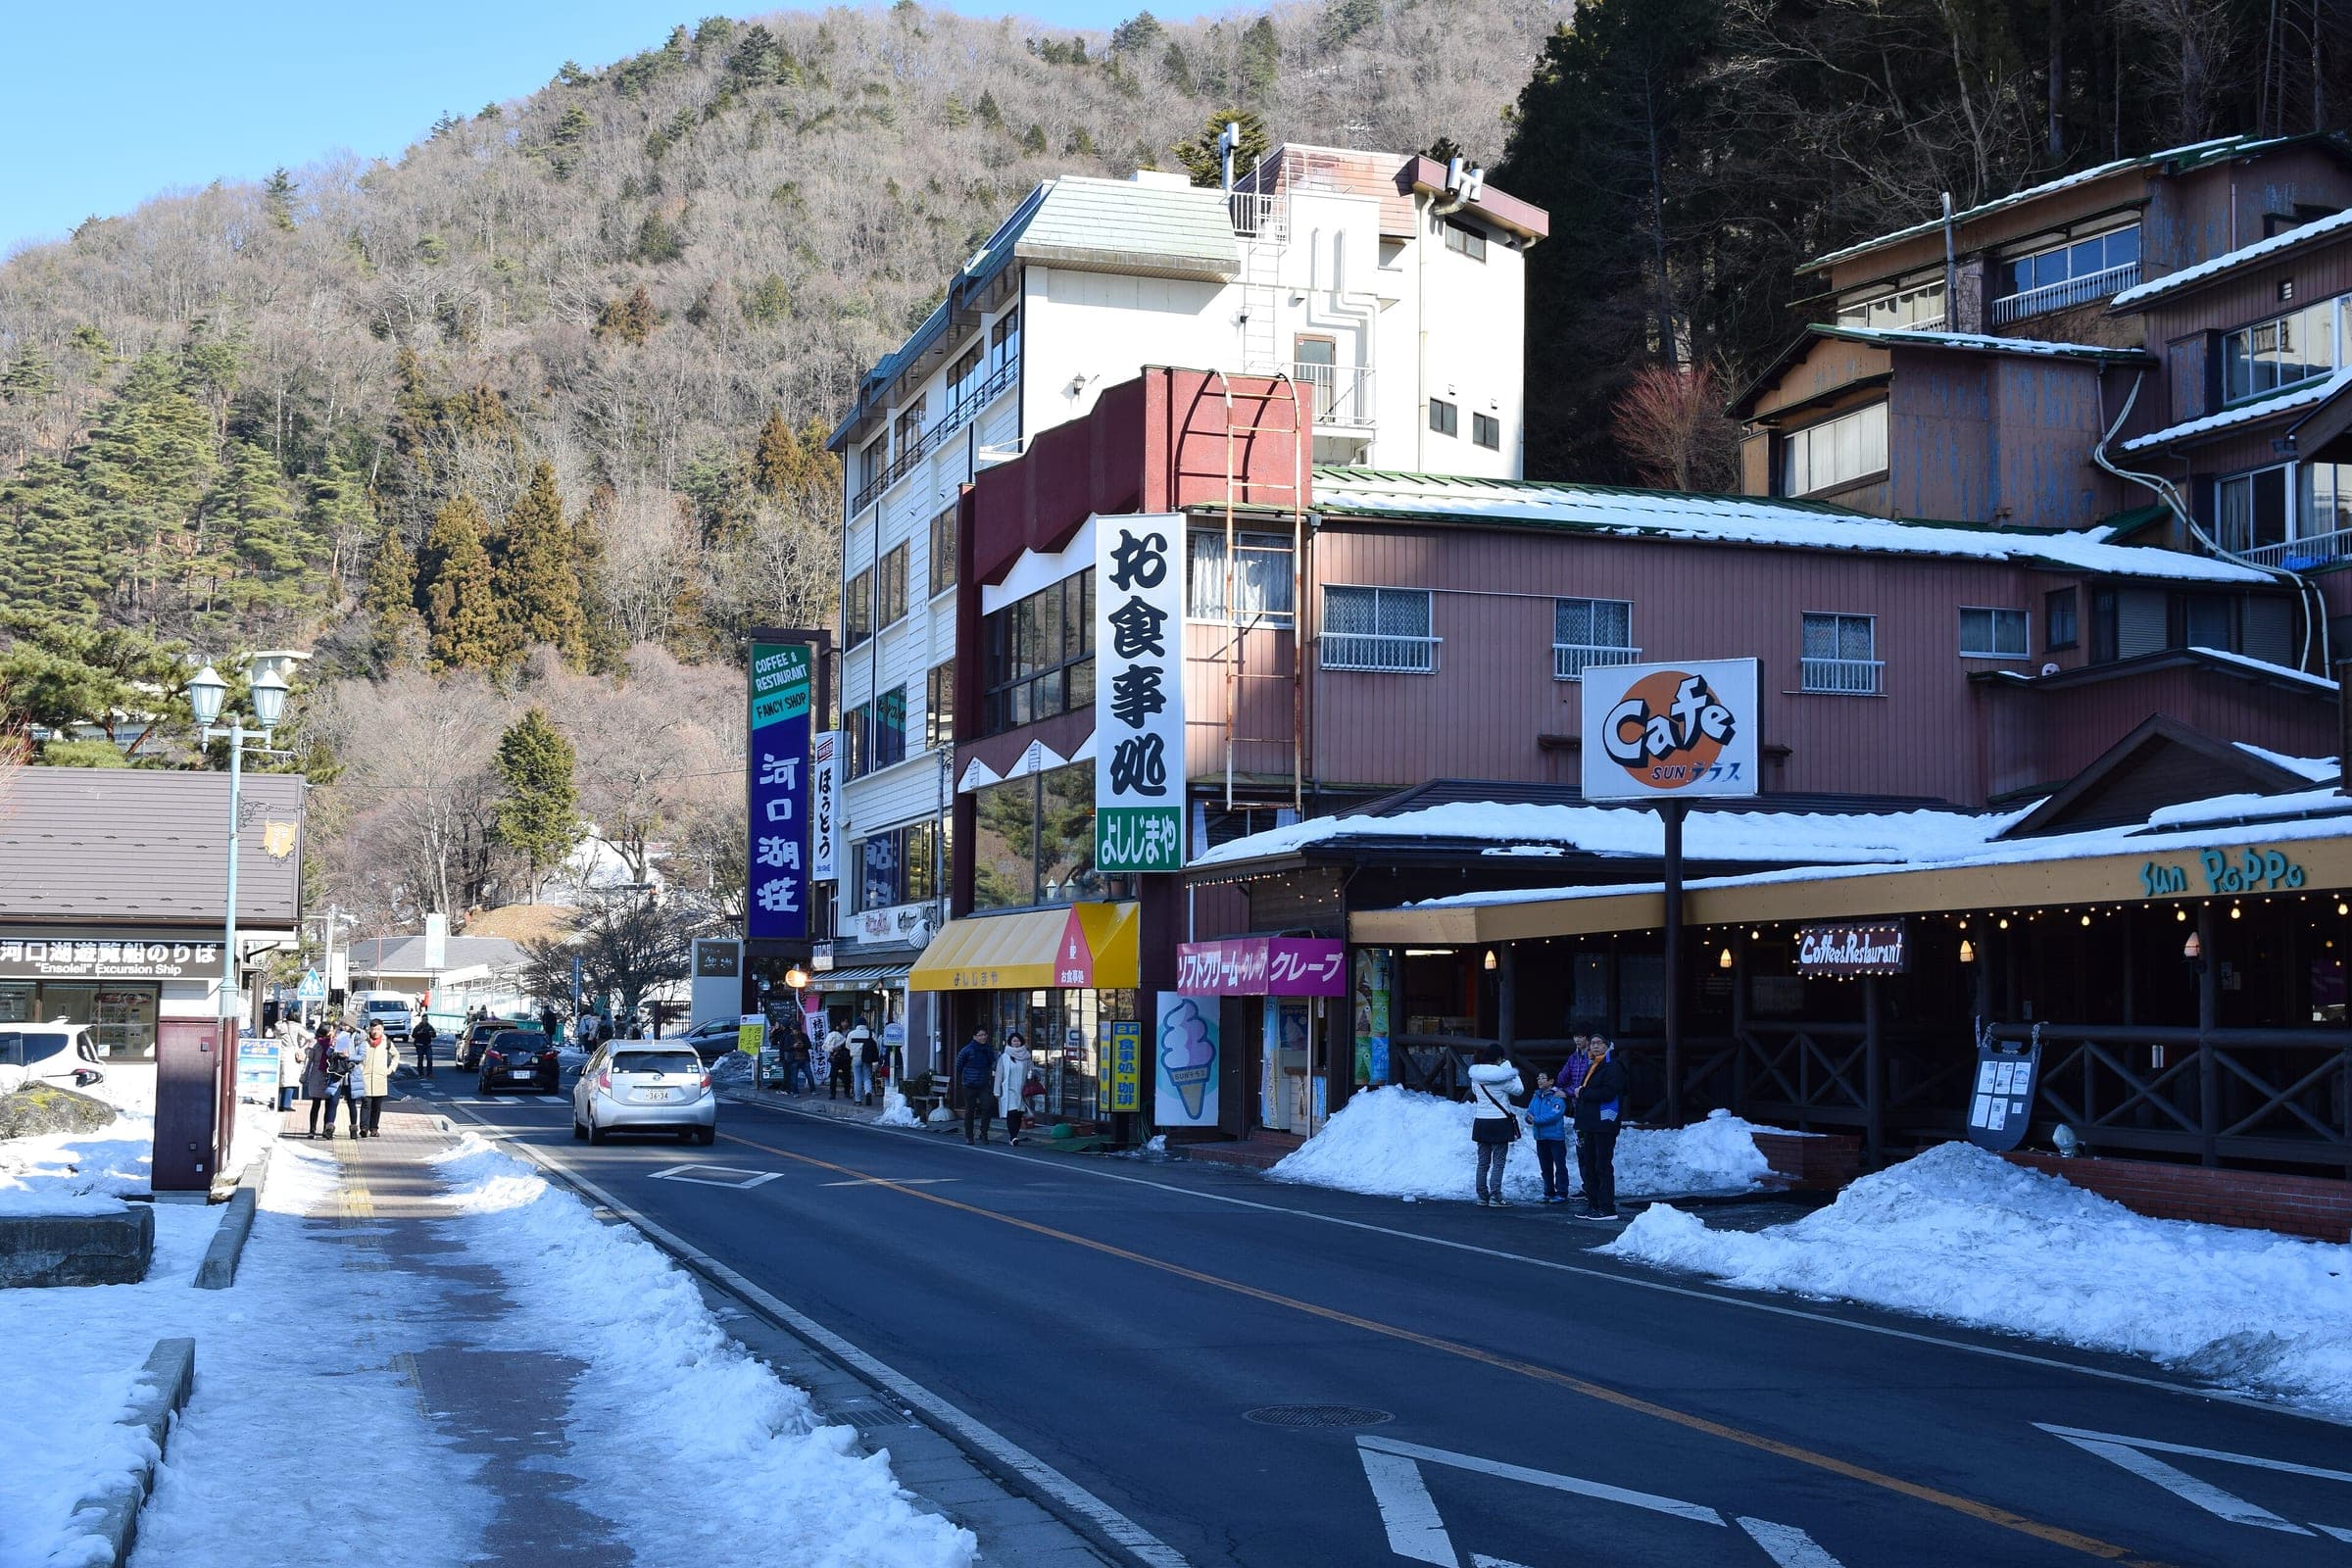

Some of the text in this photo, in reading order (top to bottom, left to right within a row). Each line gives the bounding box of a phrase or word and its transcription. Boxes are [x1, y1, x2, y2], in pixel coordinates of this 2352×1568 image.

[755, 651, 798, 673] COFFEE &
[1108, 529, 1168, 797] お食事処
[755, 663, 808, 692] RESTAURANT
[757, 692, 807, 720] FANCY SHOP
[1602, 674, 1736, 768] Cafe
[818, 767, 832, 859] ほうとう
[757, 753, 800, 912] 河口湖荘
[1101, 814, 1177, 865] よしじまや
[0, 941, 217, 963] 河口湖遊覧船のりば
[95, 963, 153, 975] Excursion
[155, 964, 182, 977] Ship
[1060, 970, 1085, 984] お食事処
[1270, 952, 1344, 982] クレープ
[1117, 1025, 1137, 1034] 2F
